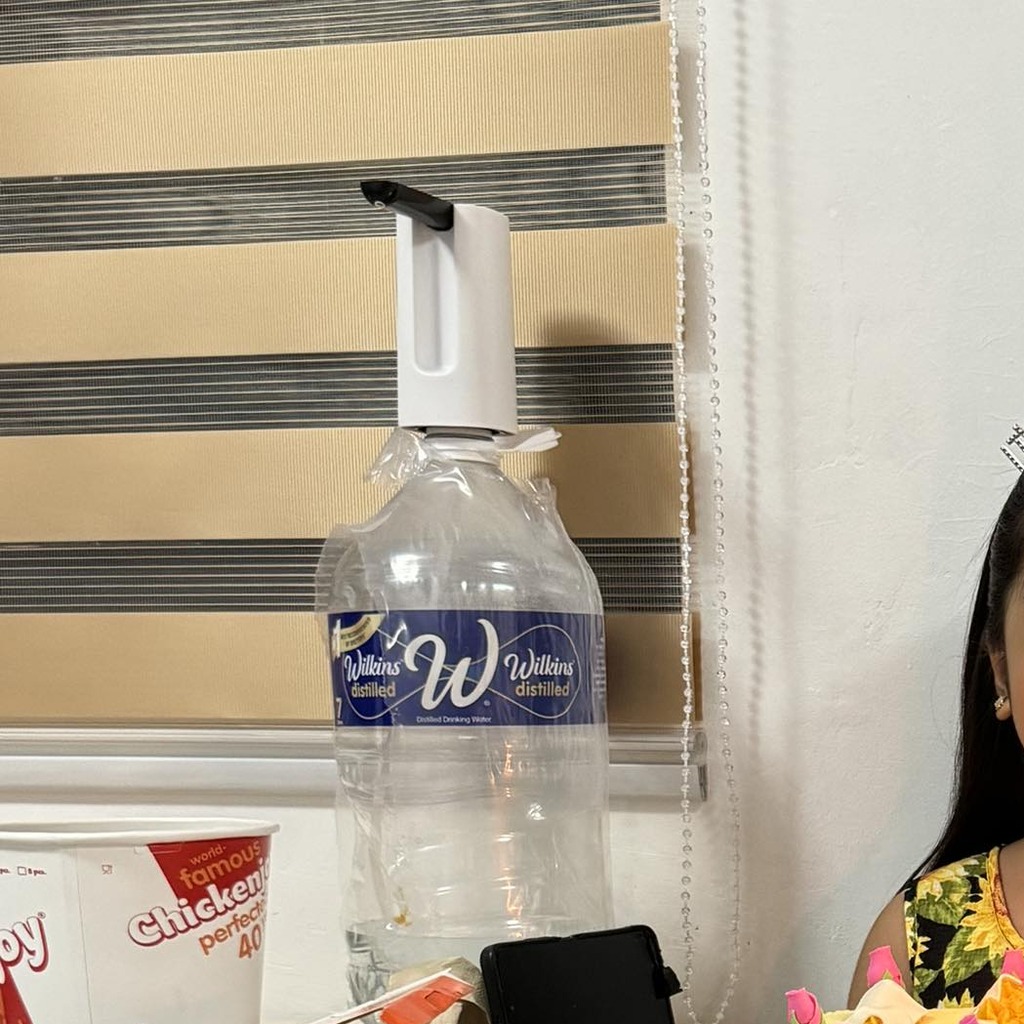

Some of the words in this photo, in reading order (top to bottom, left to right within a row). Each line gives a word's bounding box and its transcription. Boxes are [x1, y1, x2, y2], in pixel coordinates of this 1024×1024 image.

[344, 648, 402, 682] Wilkins
[404, 618, 499, 710] W
[503, 647, 576, 681] Wilkins
[351, 681, 396, 698] distilled
[515, 681, 570, 697] distilled
[179, 840, 261, 890] famous
[0, 914, 49, 973] oy
